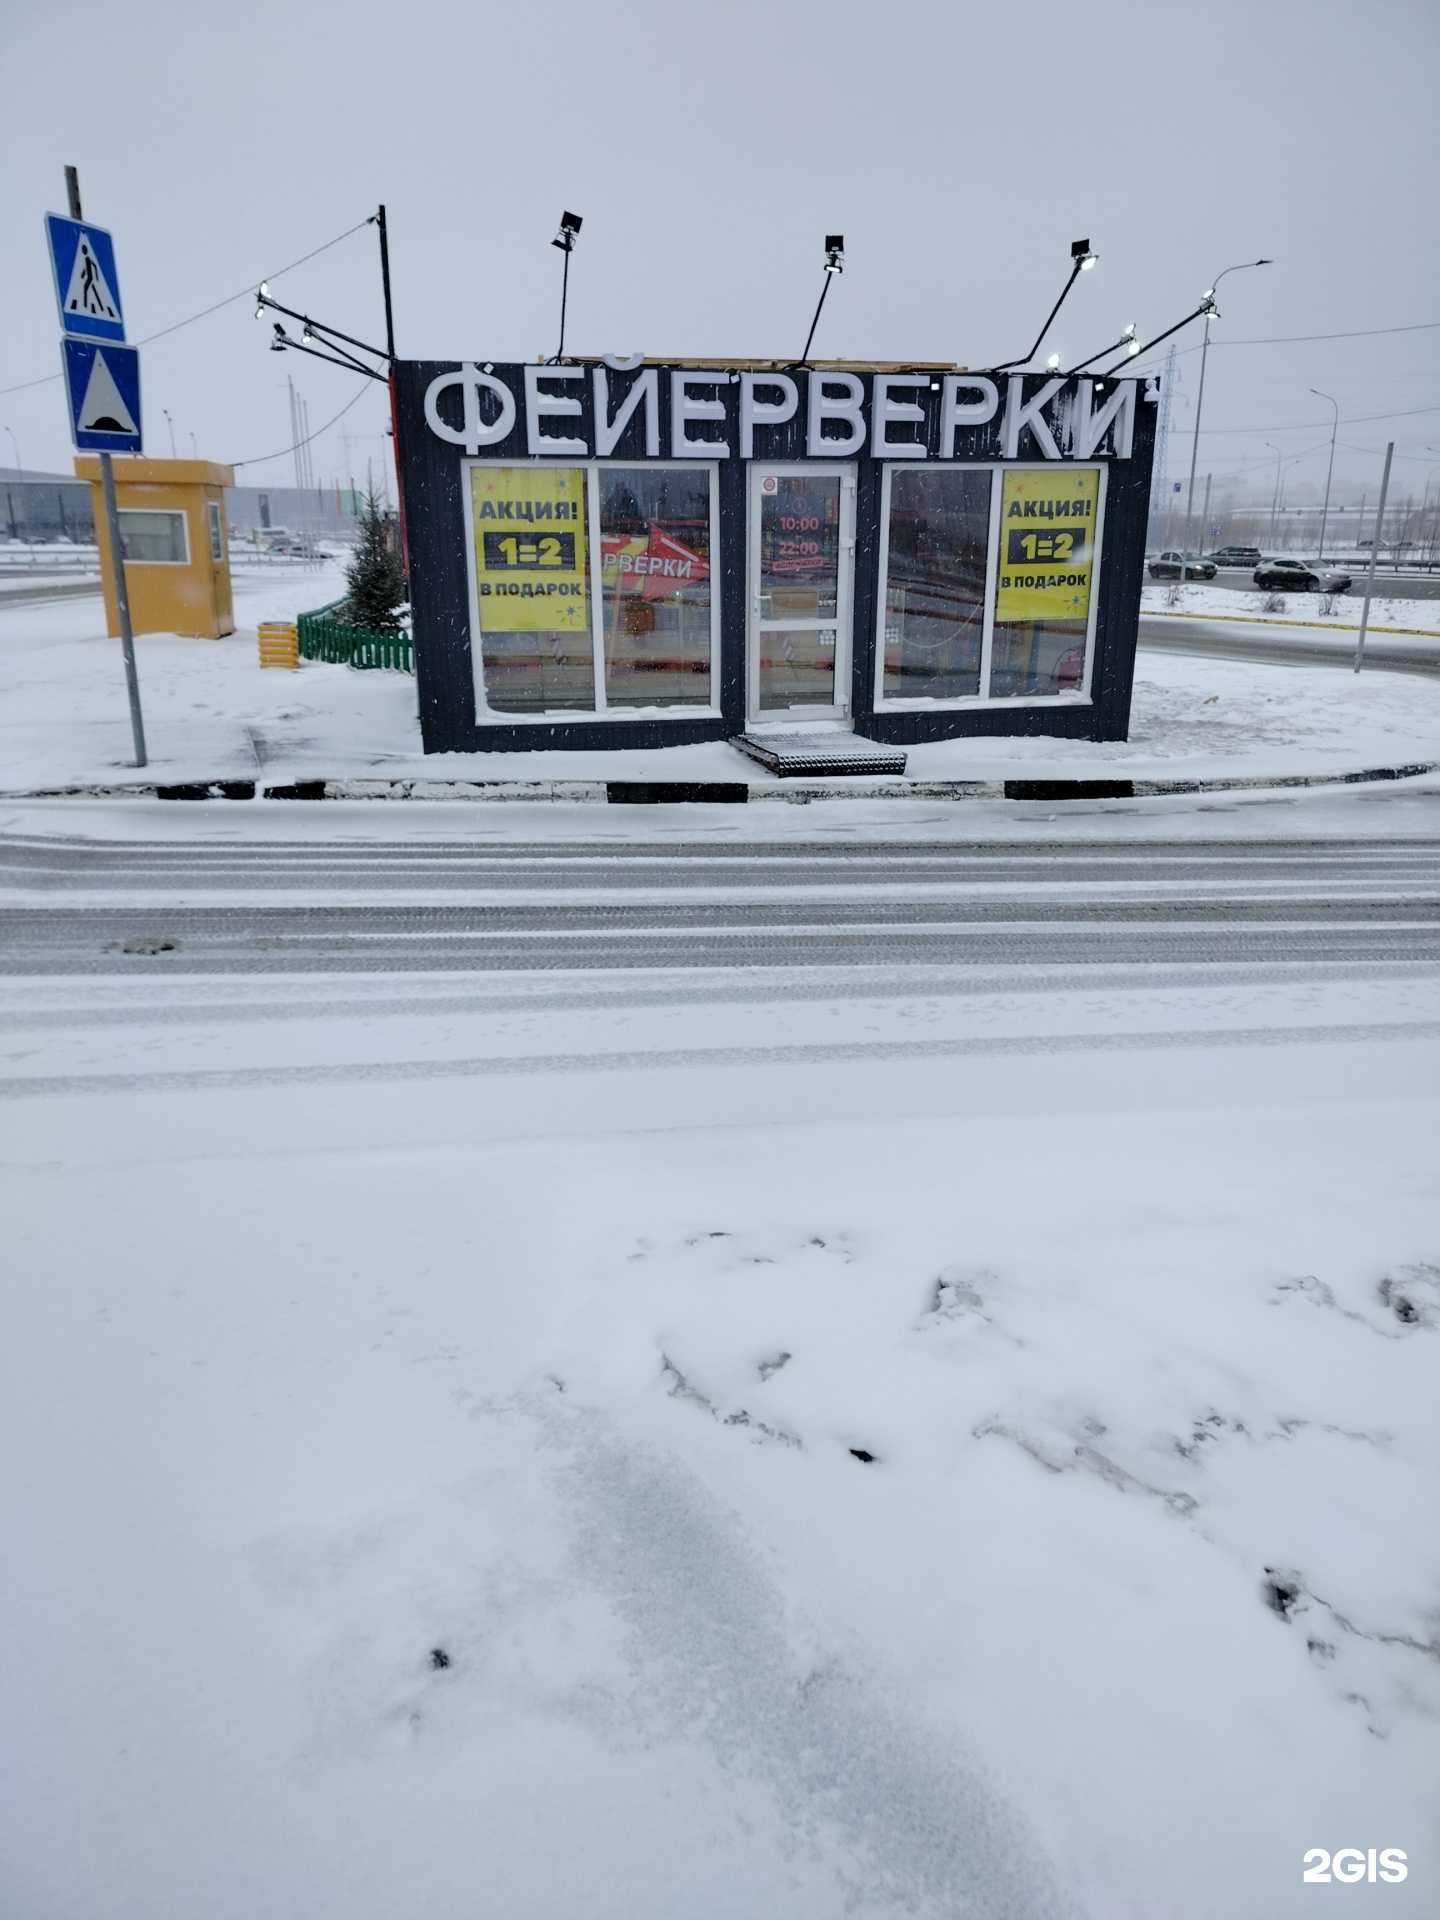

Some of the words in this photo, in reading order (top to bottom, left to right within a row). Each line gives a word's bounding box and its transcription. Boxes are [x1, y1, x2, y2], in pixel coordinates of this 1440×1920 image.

[424, 353, 1138, 460] ФЕЙЕРВЕРКИ
[480, 501, 578, 523] АКЦИЯ!
[1008, 500, 1091, 520] АКЦИЯ!
[780, 517, 819, 530] 10:00
[498, 538, 562, 565] 1=2
[779, 542, 818, 555] 22:00
[1020, 533, 1074, 560] 1=2
[599, 553, 692, 578] РВЕРКИ
[481, 583, 492, 596] В
[495, 583, 582, 598] ПОДАРОК
[1001, 577, 1011, 588] В
[1014, 574, 1087, 589] ПОДАРОК
